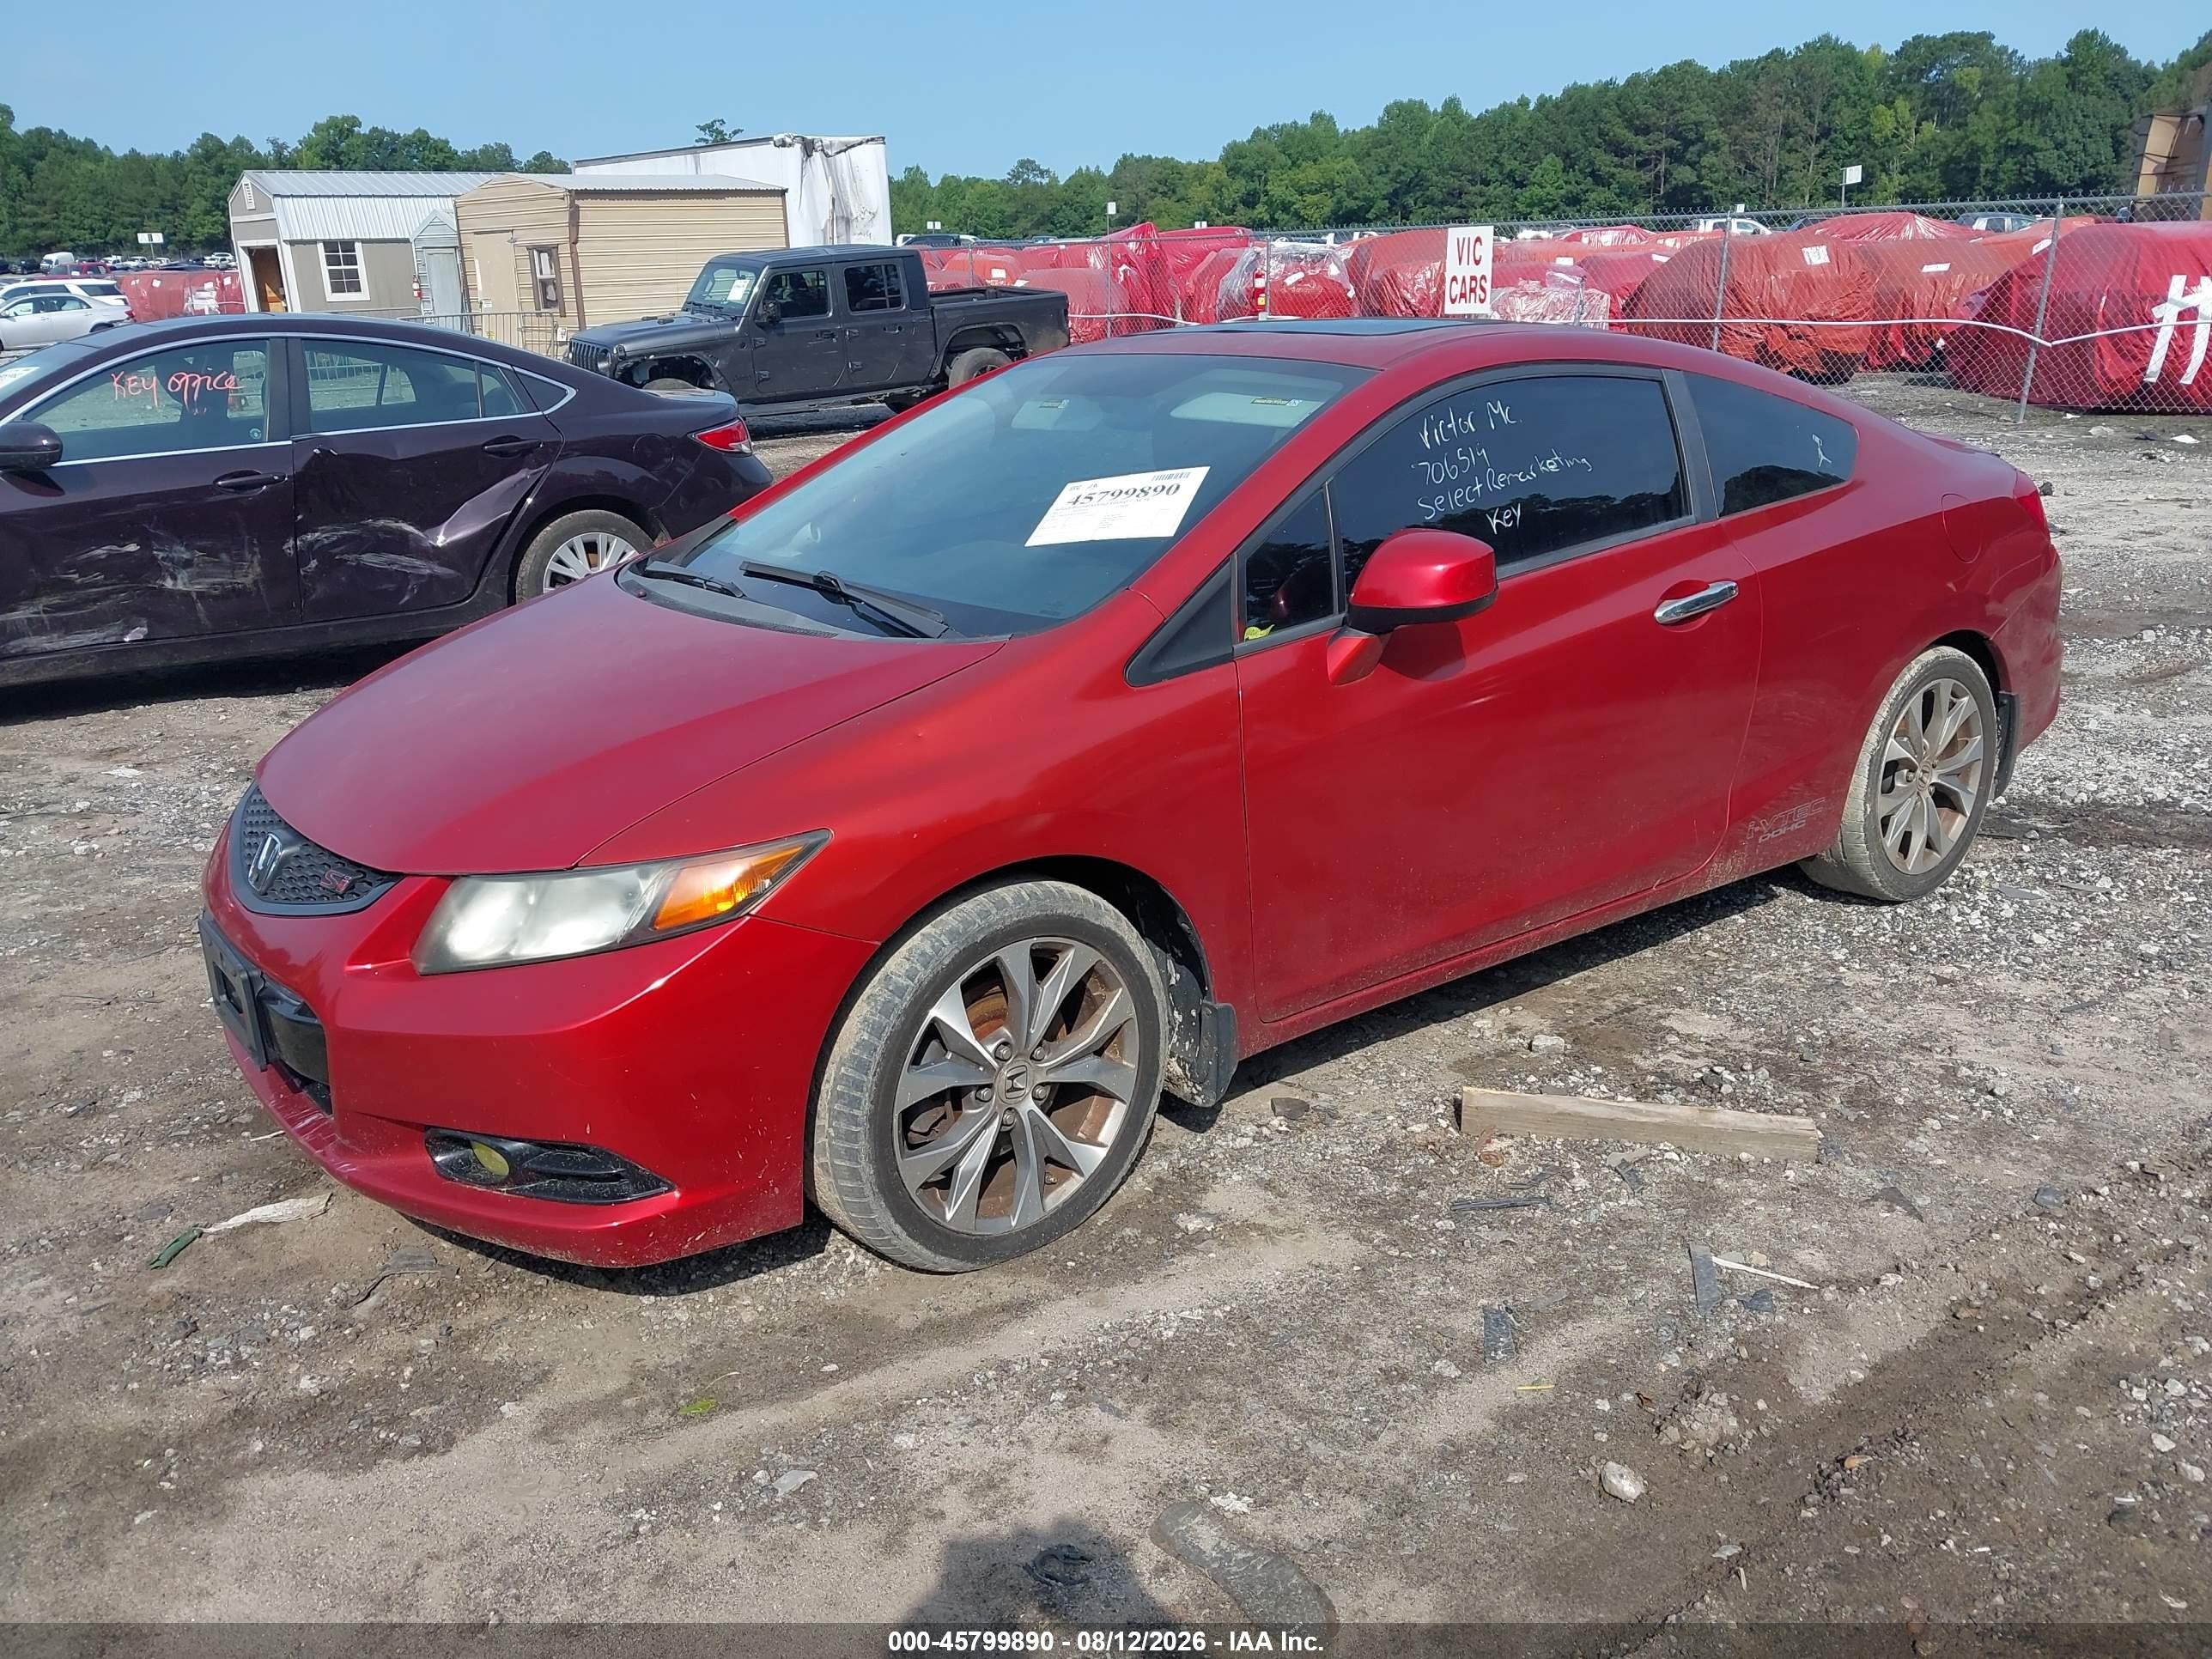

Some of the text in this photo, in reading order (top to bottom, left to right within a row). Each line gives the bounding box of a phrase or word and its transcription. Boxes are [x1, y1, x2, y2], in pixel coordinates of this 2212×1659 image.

[1456, 235, 1483, 266] VIC
[1449, 274, 1487, 304] CARS
[1419, 407, 1476, 450] Victor
[1418, 445, 1491, 485] 706514
[1066, 483, 1182, 507] 45799890
[1417, 448, 1594, 520] Select Remarketing
[1758, 819, 1807, 844] DOHC
[319, 869, 352, 893] Si
